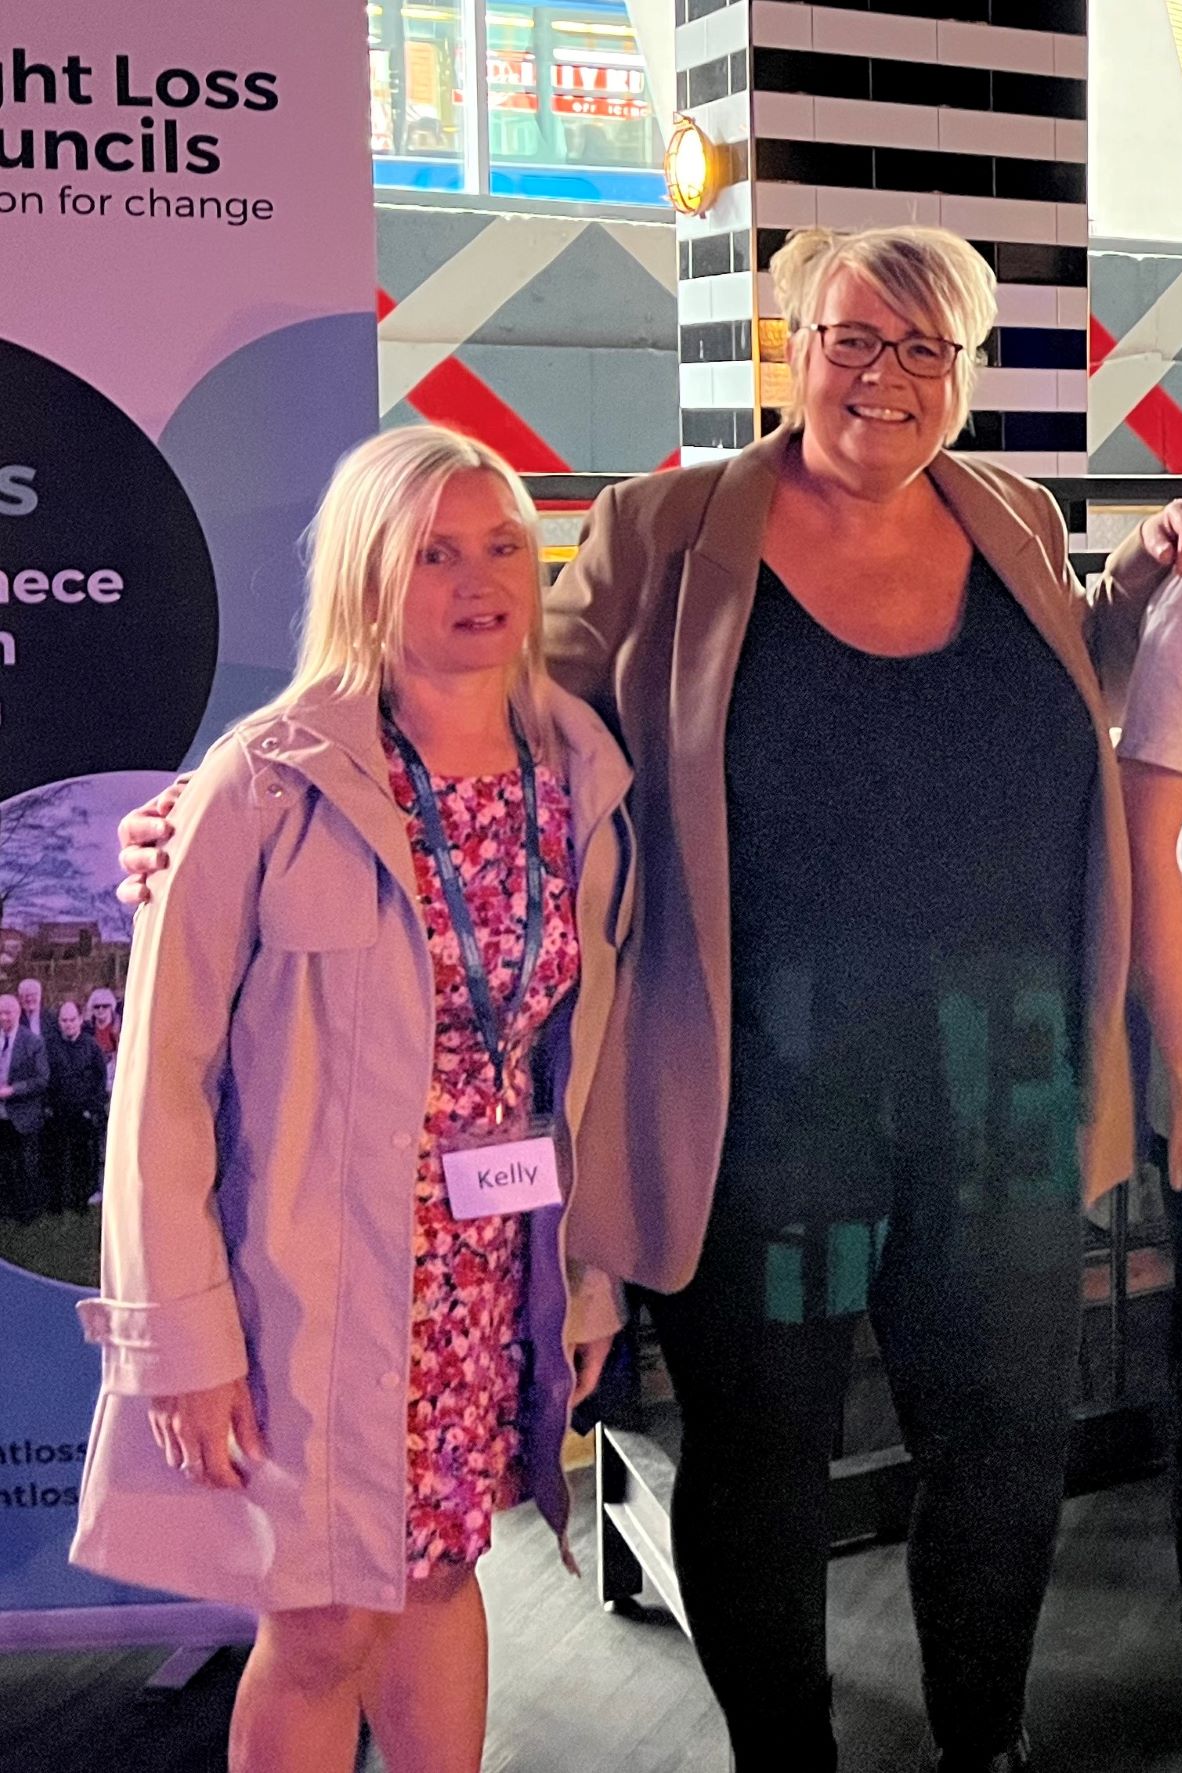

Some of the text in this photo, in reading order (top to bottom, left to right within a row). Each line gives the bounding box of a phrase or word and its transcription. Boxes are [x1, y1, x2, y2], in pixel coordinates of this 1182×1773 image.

[0, 48, 279, 111] ht Loss
[0, 116, 221, 175] uncils
[0, 185, 275, 226] on for change
[478, 1161, 537, 1190] Kelly
